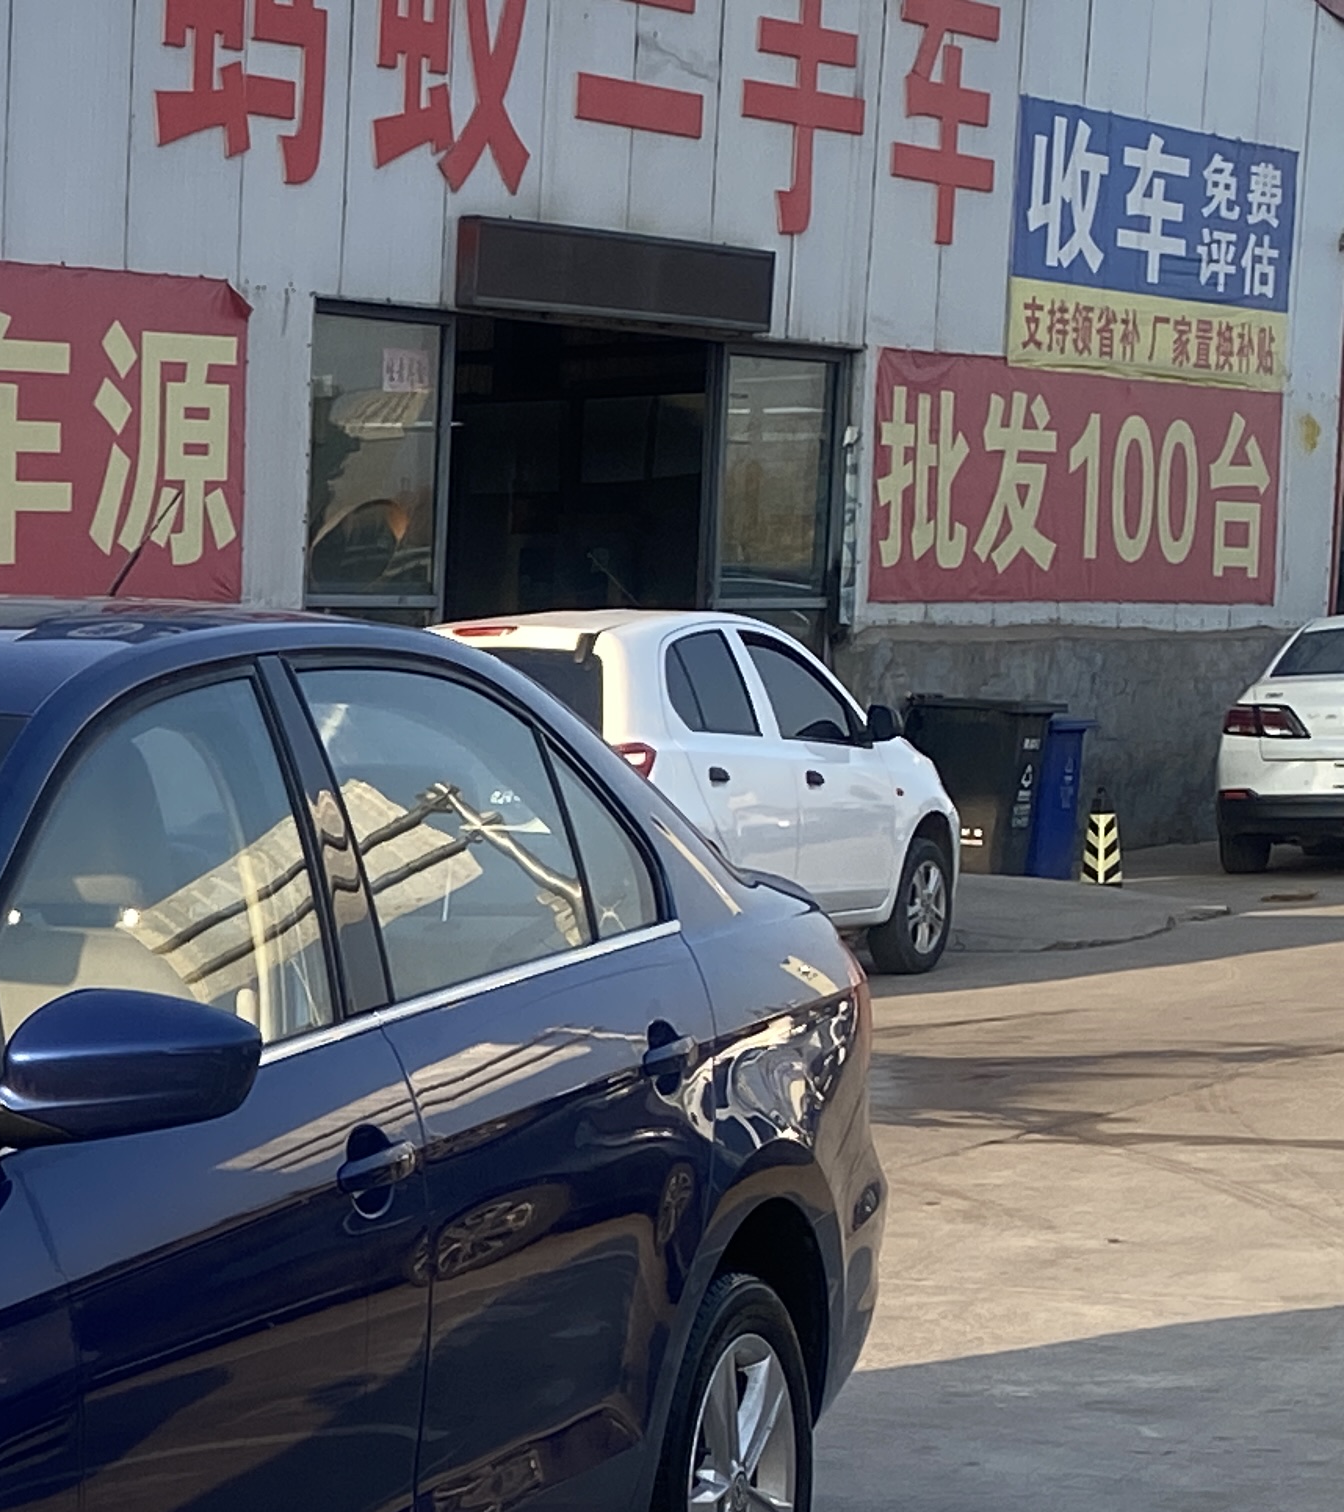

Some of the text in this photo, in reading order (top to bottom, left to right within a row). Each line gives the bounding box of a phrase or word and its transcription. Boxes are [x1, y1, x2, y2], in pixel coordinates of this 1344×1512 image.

[1025, 115, 1191, 285] 收车
[1201, 152, 1283, 228] 免费
[1195, 228, 1280, 299] 评估
[1021, 295, 1277, 376] 支持领省补 厂家置换补贴
[876, 385, 1271, 579] 批发100台
